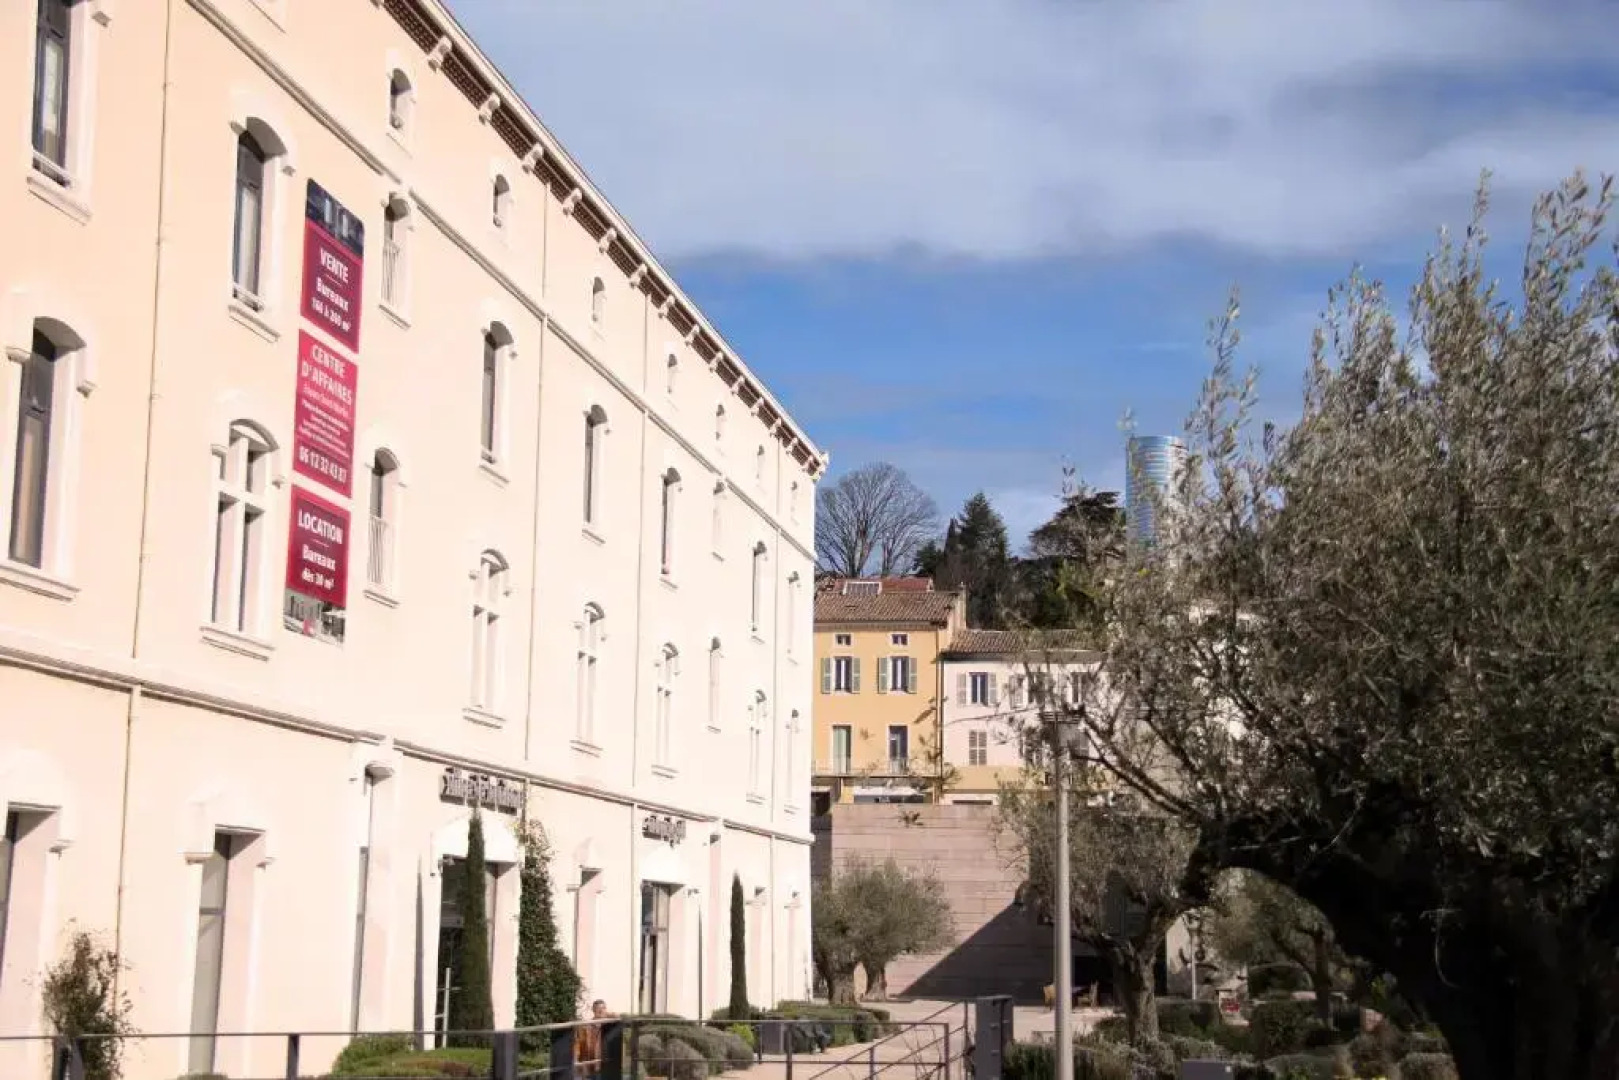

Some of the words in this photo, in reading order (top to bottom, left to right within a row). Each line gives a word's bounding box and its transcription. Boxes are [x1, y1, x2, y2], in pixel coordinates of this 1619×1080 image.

[320, 246, 349, 284] VENTE
[316, 276, 349, 312] Bureaux
[312, 344, 347, 379] CENTRE
[301, 361, 352, 406] D'AFFAIRES
[297, 508, 344, 545] LOCATION
[302, 543, 336, 571] Bureaux
